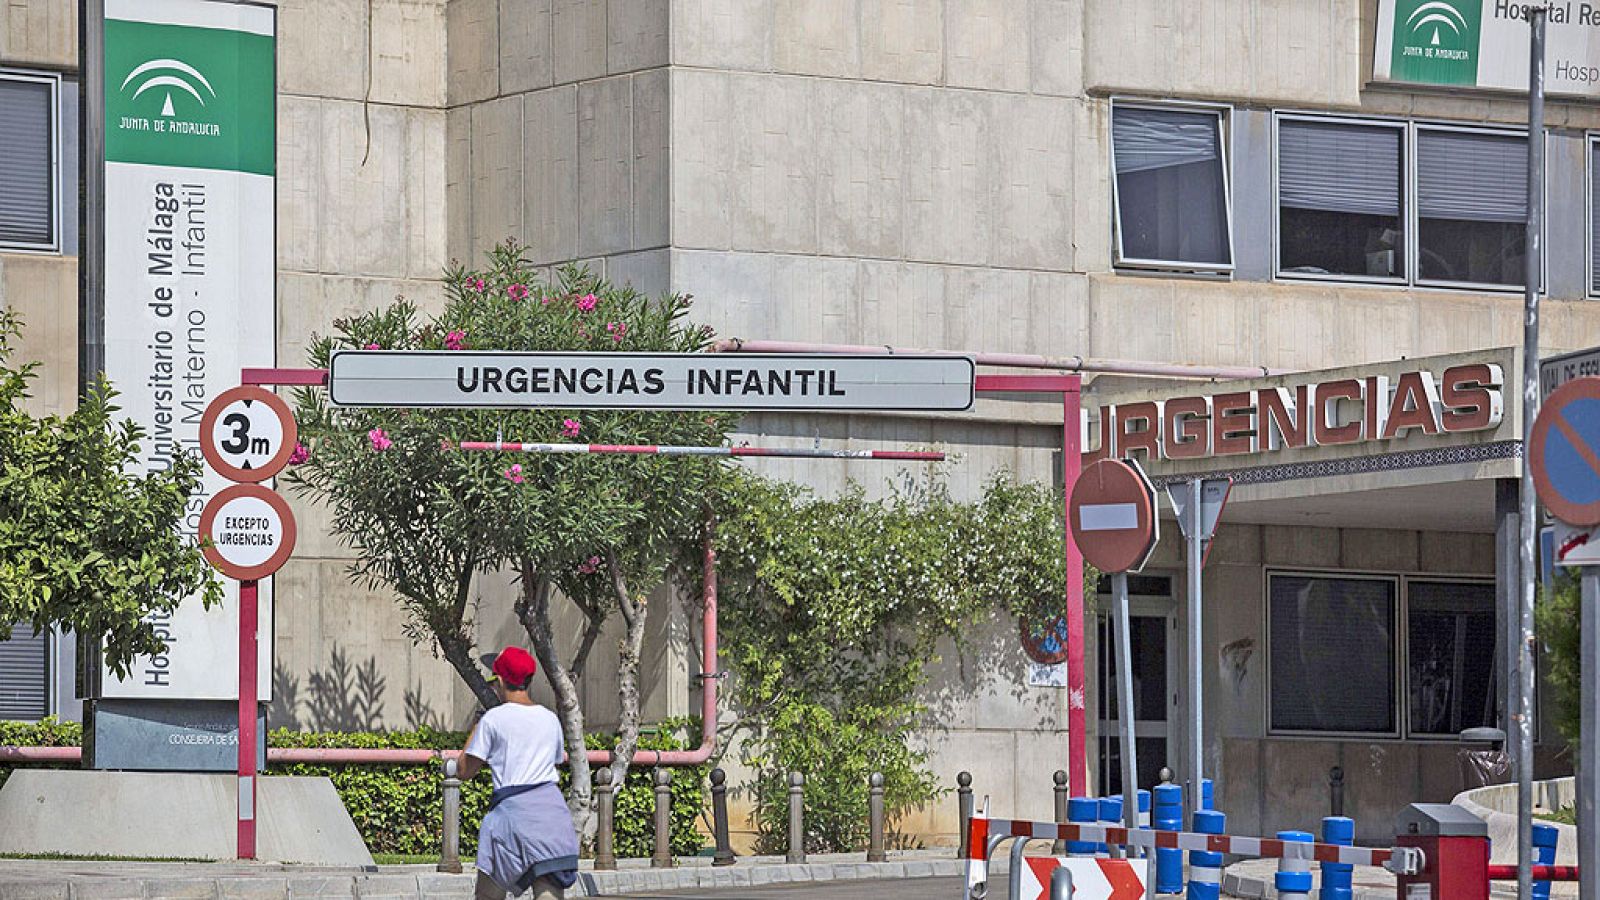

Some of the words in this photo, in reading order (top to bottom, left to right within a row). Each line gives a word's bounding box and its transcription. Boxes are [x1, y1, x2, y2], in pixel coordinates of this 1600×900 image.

[1494, 0, 1571, 24] Hostal
[119, 116, 149, 131] JUNTA
[153, 119, 165, 132] DE
[146, 182, 179, 275] Málaga
[181, 183, 206, 276] Infantil
[148, 286, 173, 318] de
[180, 309, 206, 425] Materno
[456, 366, 665, 395] URGENCIAS
[686, 369, 846, 396] INFANTIL
[147, 330, 173, 473] Universitario
[219, 532, 274, 546] URGENCIAS
[225, 516, 270, 531] EXCEPTO
